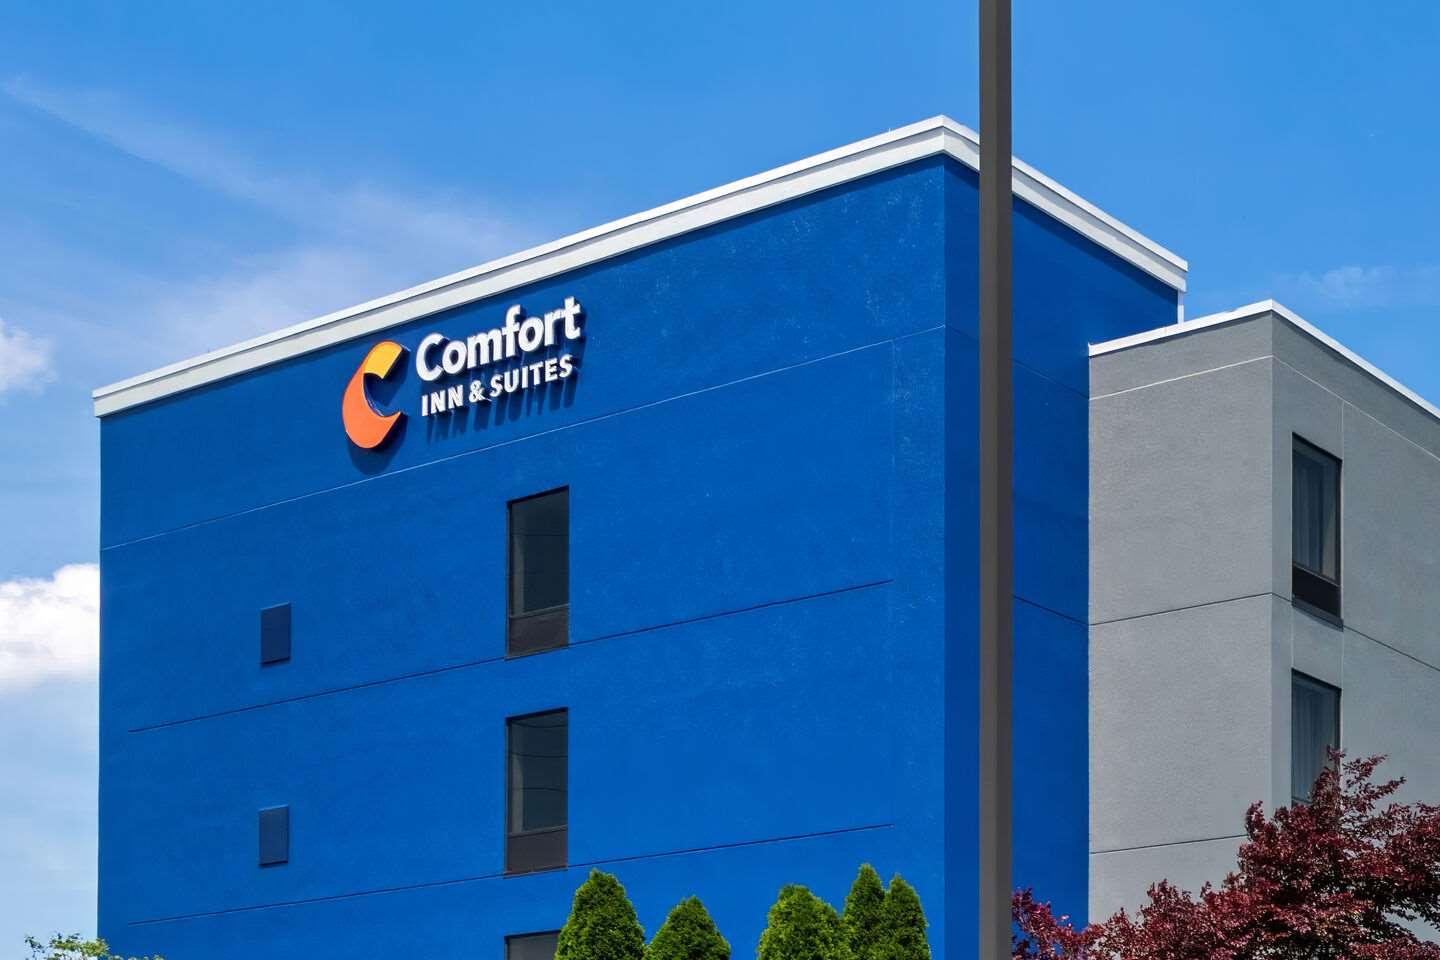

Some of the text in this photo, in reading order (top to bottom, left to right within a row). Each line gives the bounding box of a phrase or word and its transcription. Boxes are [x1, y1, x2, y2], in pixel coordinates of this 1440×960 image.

[415, 296, 582, 382] Comfort
[421, 353, 574, 417] INN & SUITES
